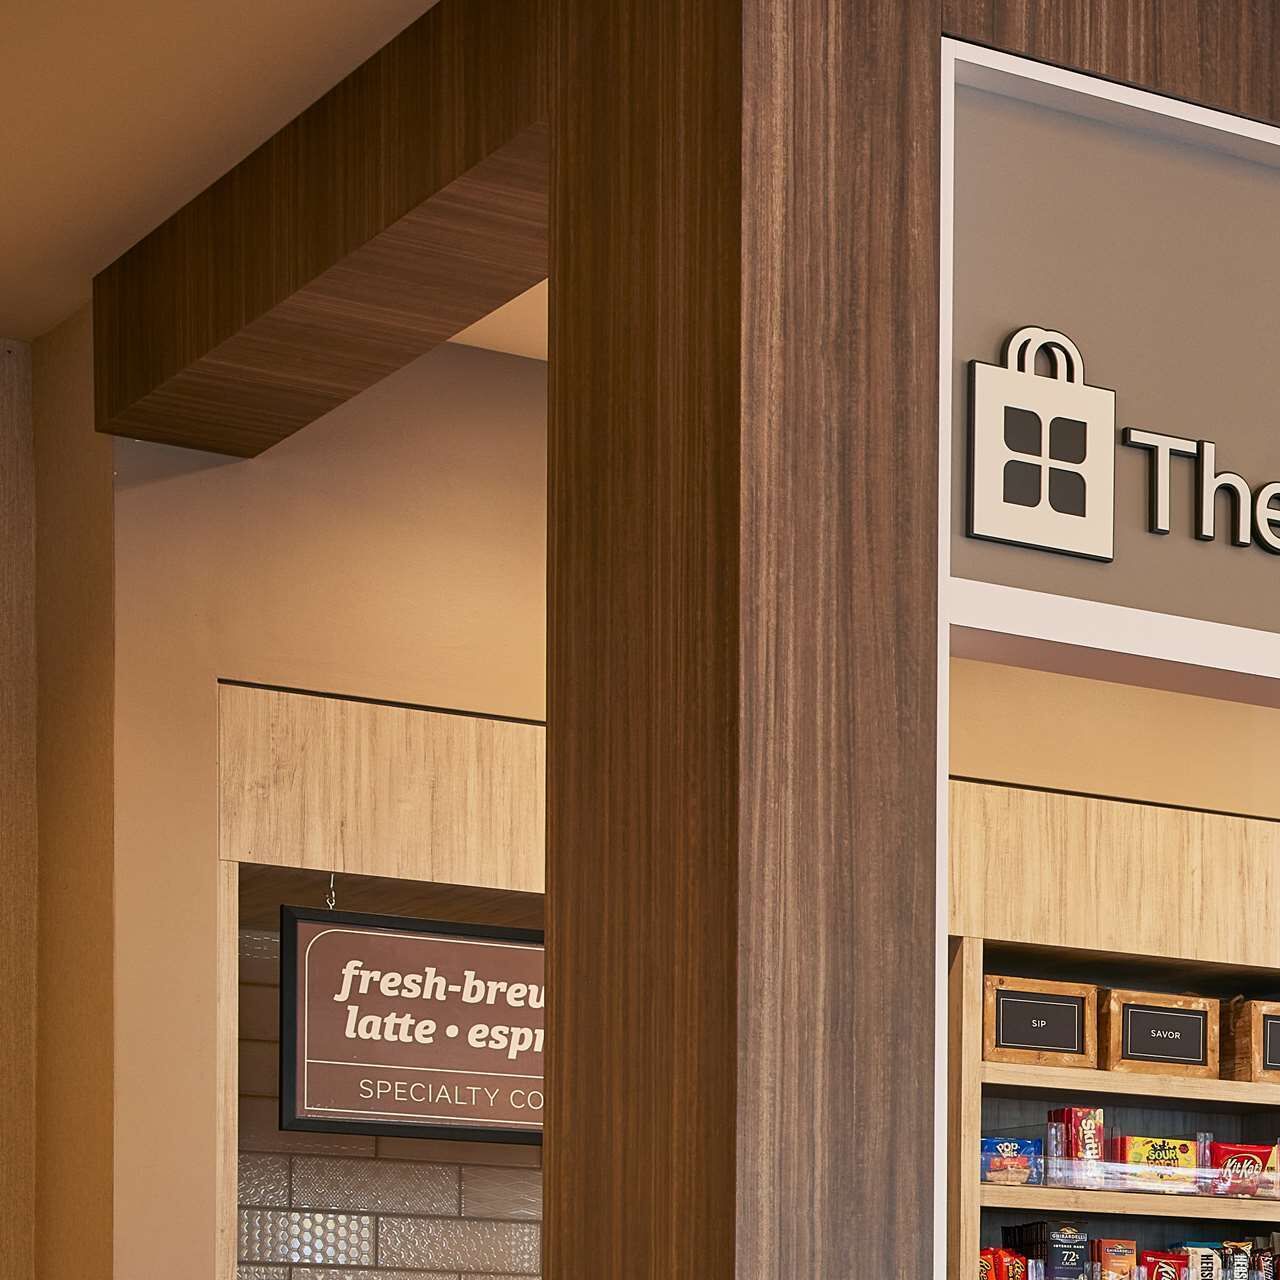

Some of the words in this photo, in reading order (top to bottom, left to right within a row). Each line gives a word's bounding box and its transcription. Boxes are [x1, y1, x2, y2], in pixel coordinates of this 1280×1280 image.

[345, 1005, 437, 1044] latte
[1031, 1018, 1047, 1029] SIP
[1150, 1029, 1181, 1041] SAVOR
[359, 1079, 500, 1107] SPECIALTY
[1148, 1148, 1178, 1161] SOUR
